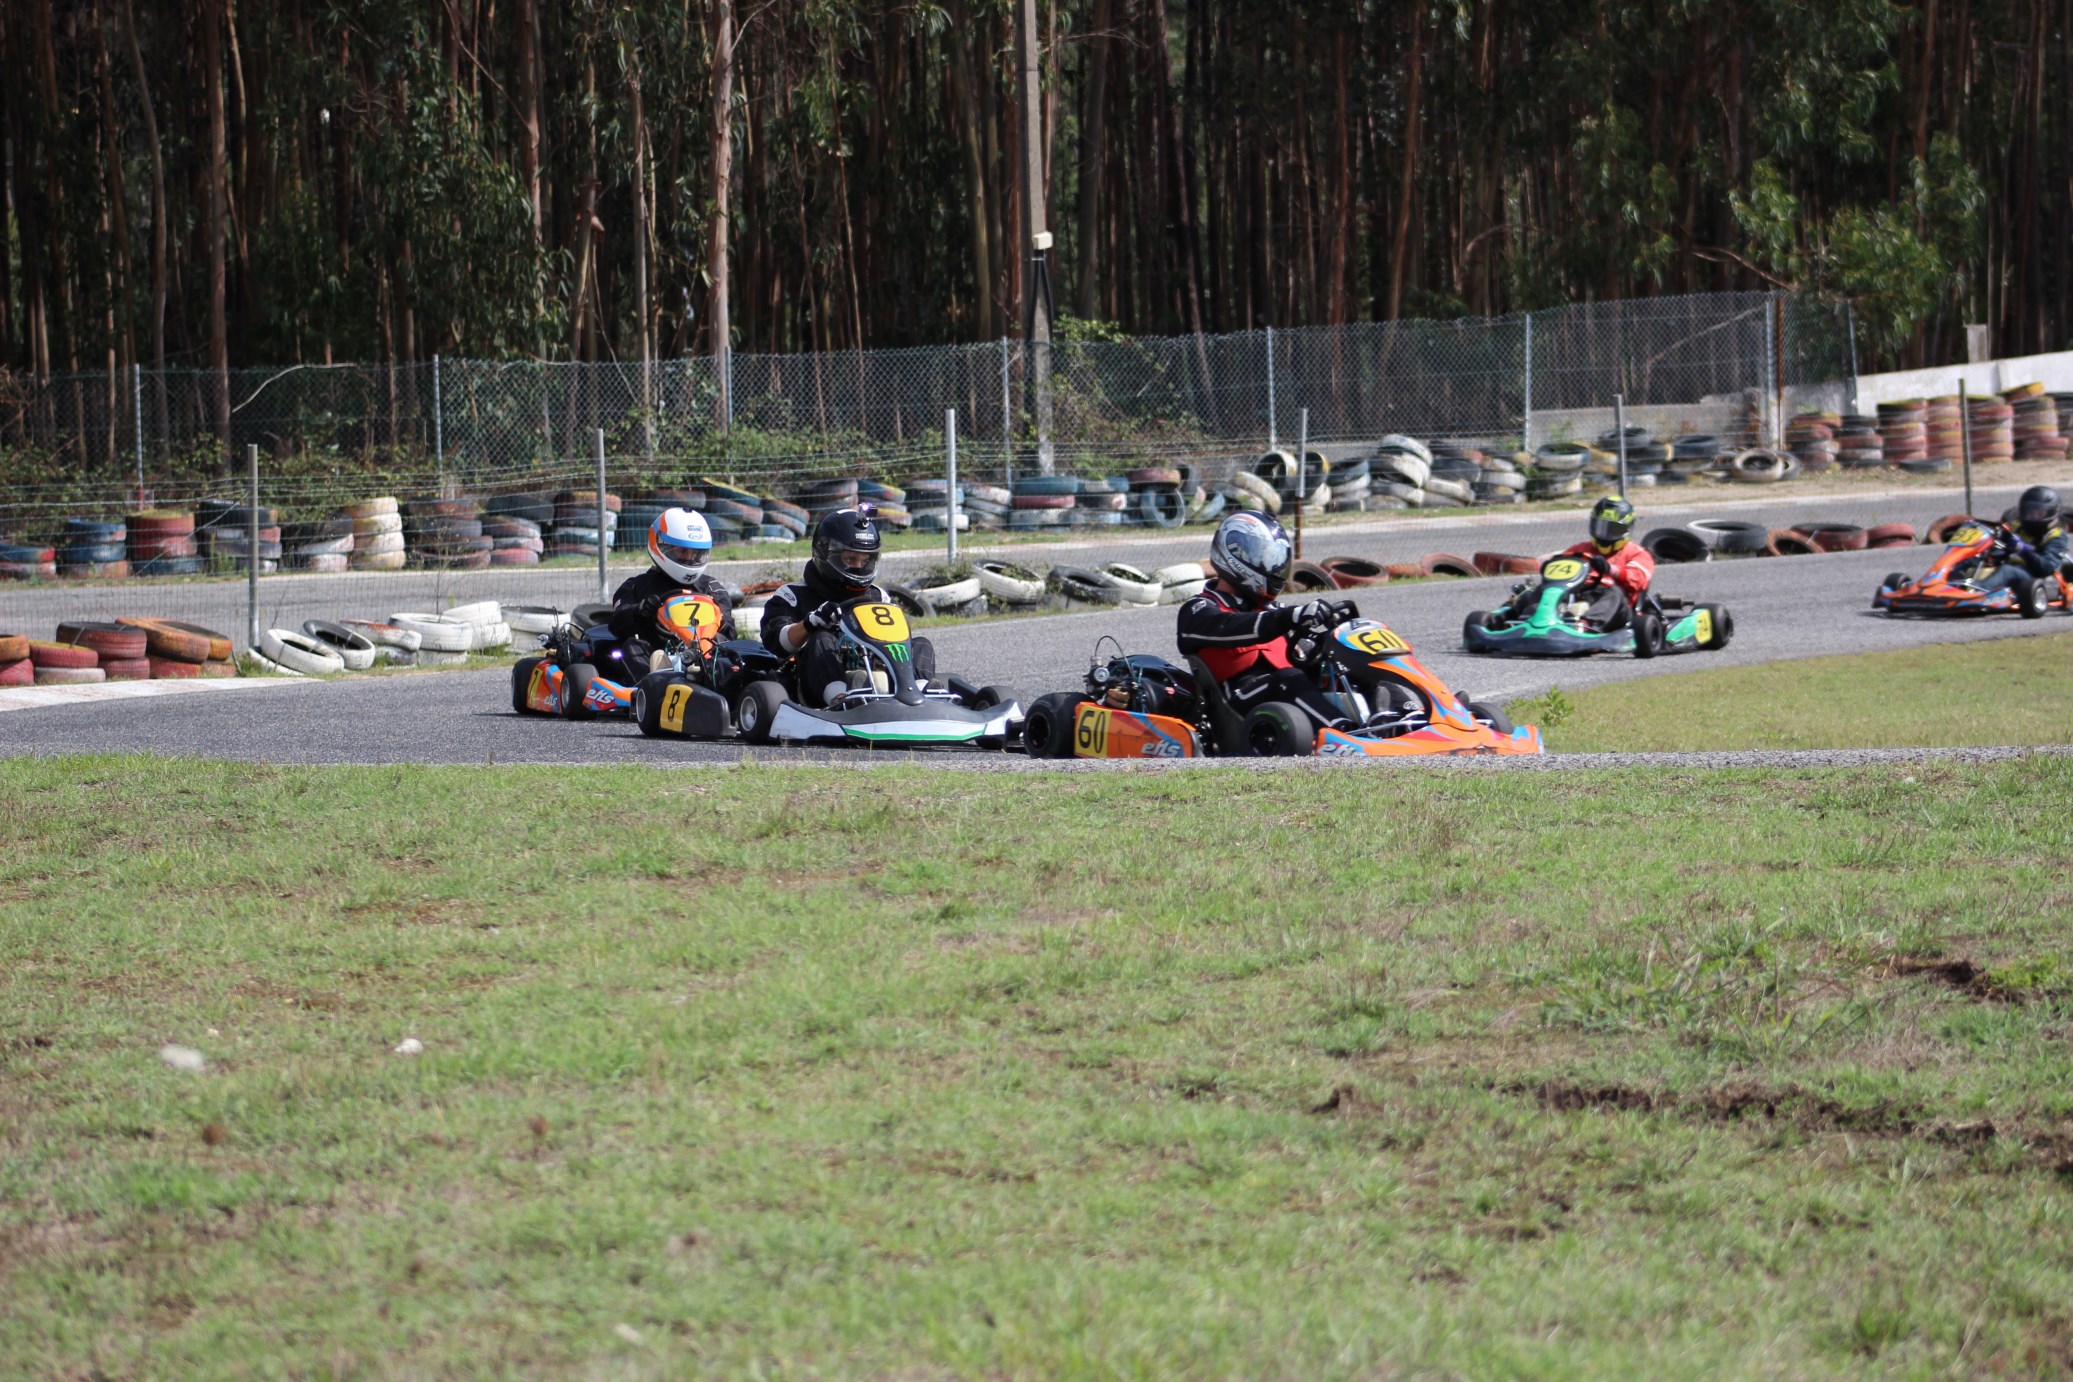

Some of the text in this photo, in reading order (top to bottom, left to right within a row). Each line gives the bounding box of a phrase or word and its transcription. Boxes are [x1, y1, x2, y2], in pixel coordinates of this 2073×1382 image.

[1549, 564, 1572, 575] 74
[683, 602, 701, 625] 7
[871, 606, 895, 626] 8
[1358, 631, 1403, 652] 60
[668, 690, 681, 722] 8
[1078, 710, 1106, 754] 60
